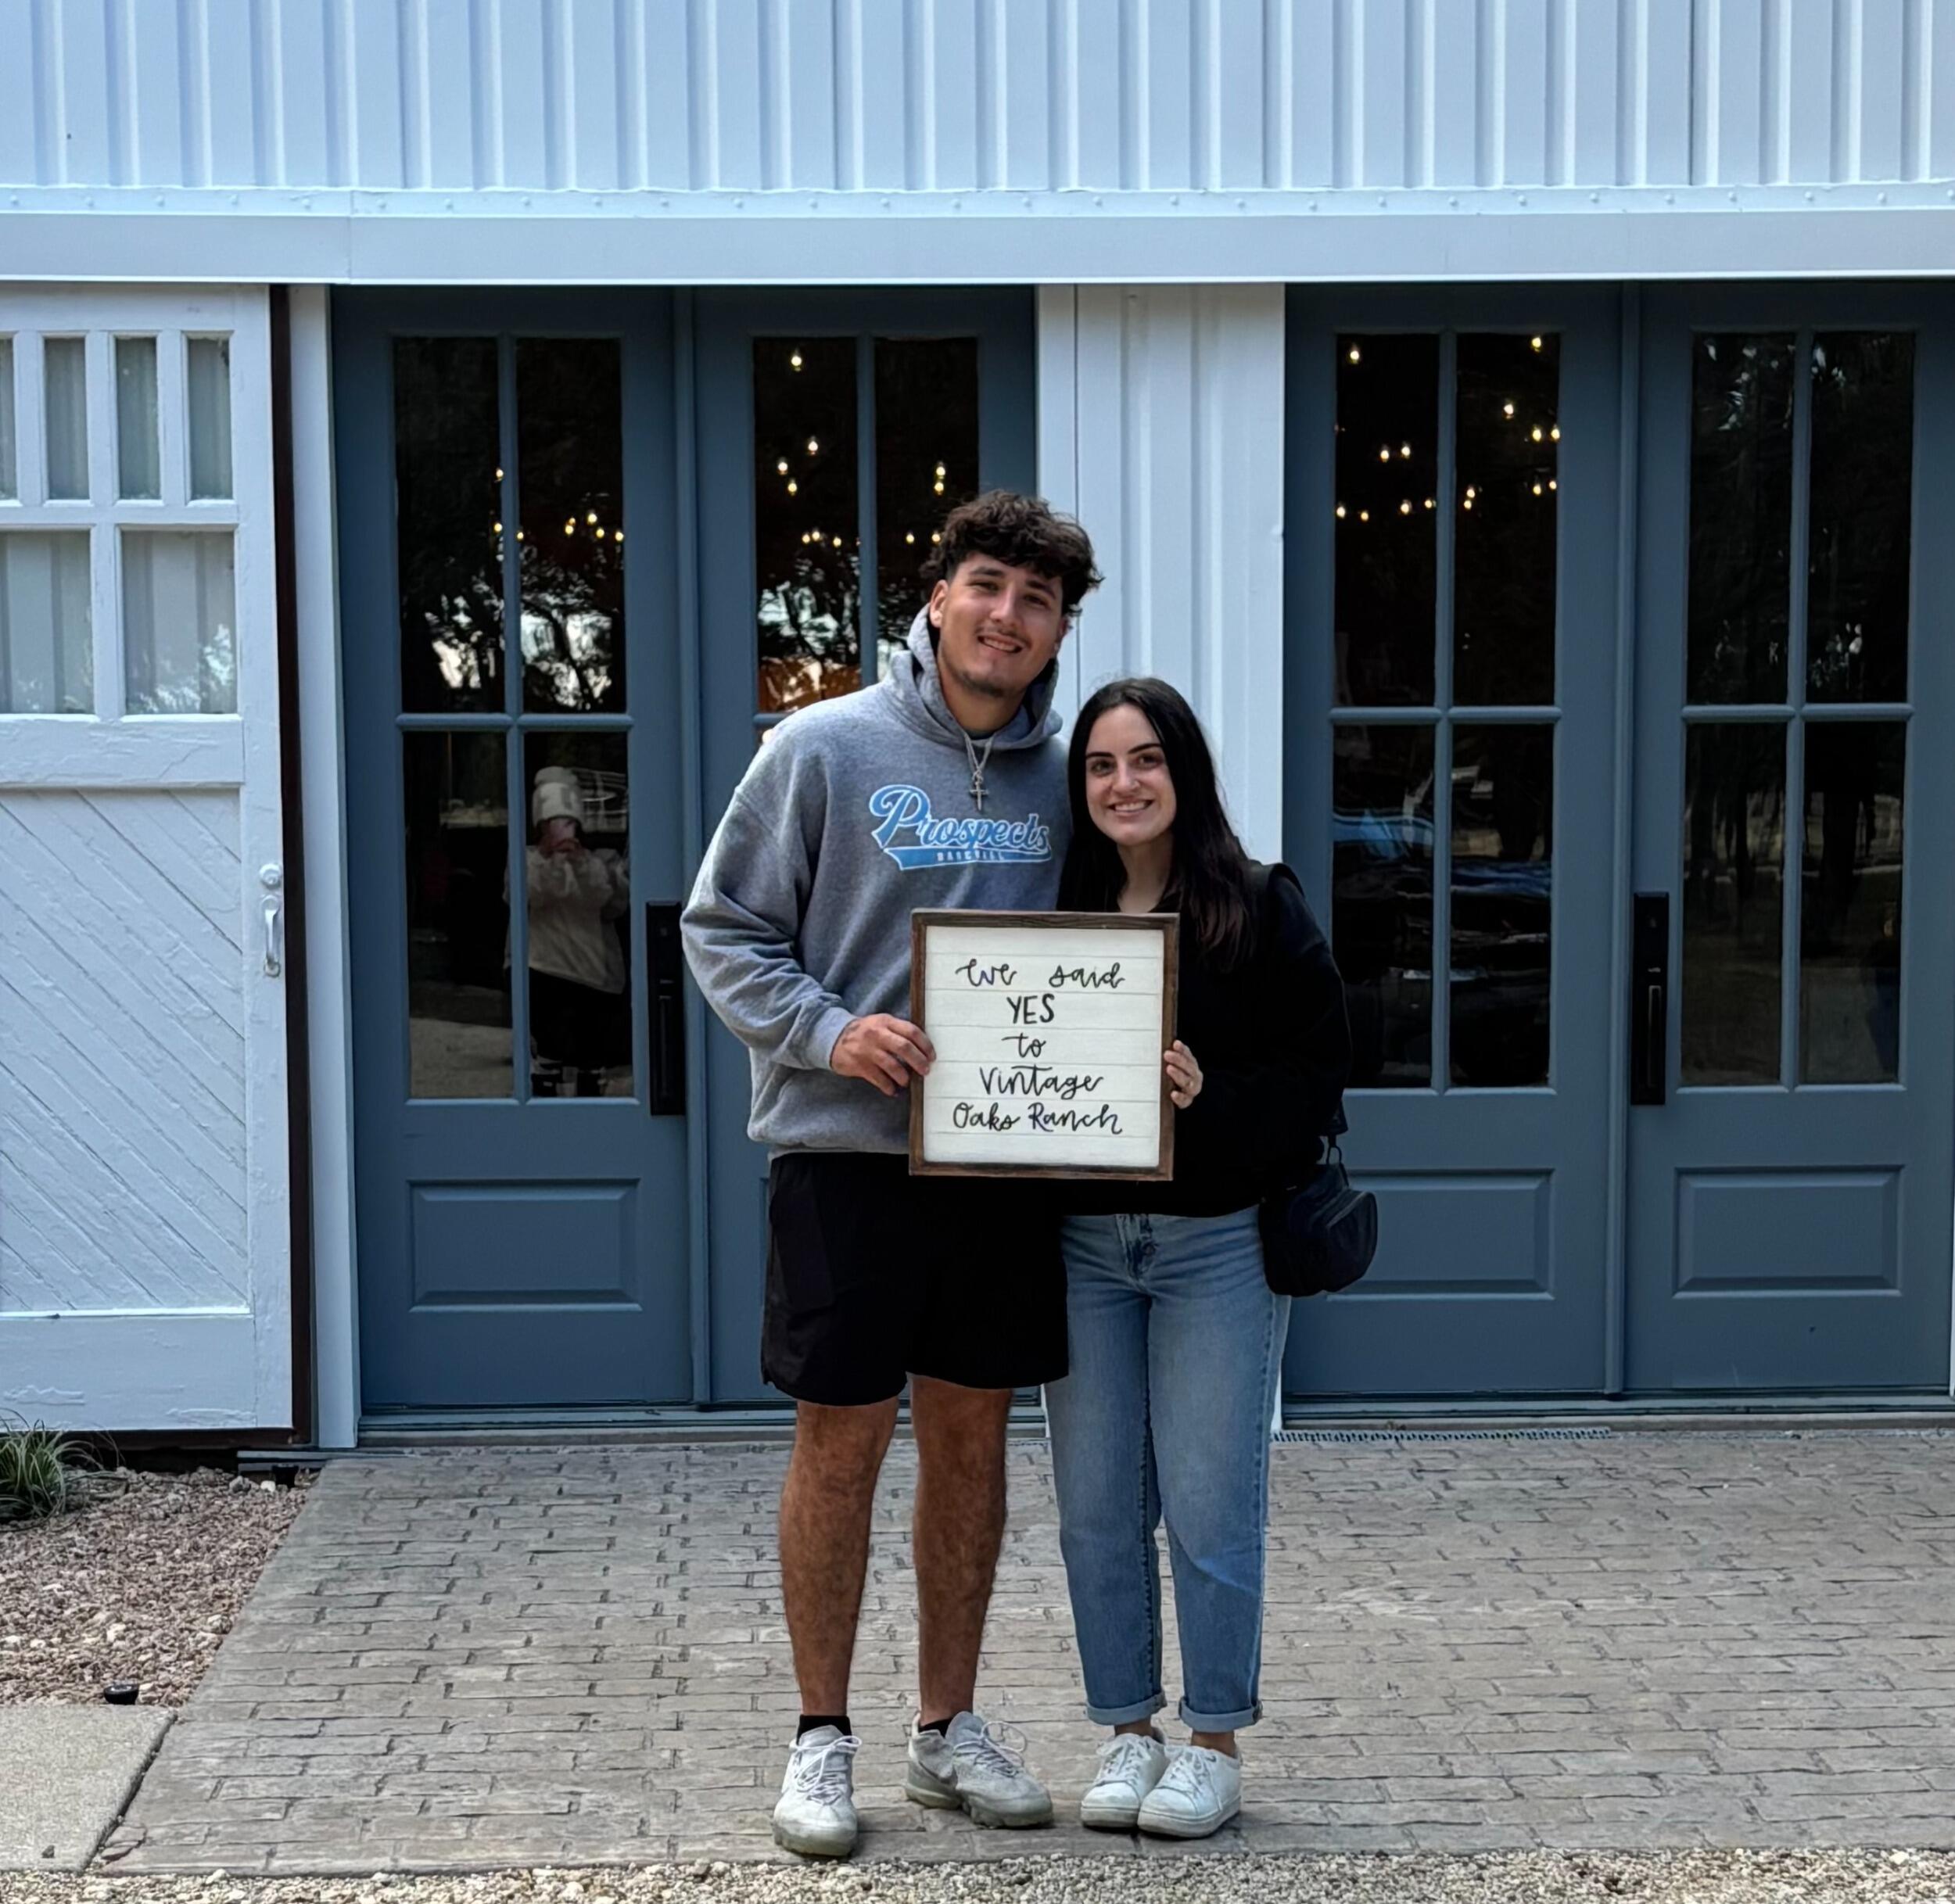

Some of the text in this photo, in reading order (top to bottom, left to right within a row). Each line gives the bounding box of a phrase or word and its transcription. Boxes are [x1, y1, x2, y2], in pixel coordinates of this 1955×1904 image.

[869, 784, 1051, 854] Prospects
[1049, 963, 1125, 988] said
[1006, 993, 1054, 1024] YES
[1002, 1033, 1046, 1057] to
[980, 1065, 1103, 1100] Vintage
[953, 1103, 1122, 1135] Oaks Ranch
